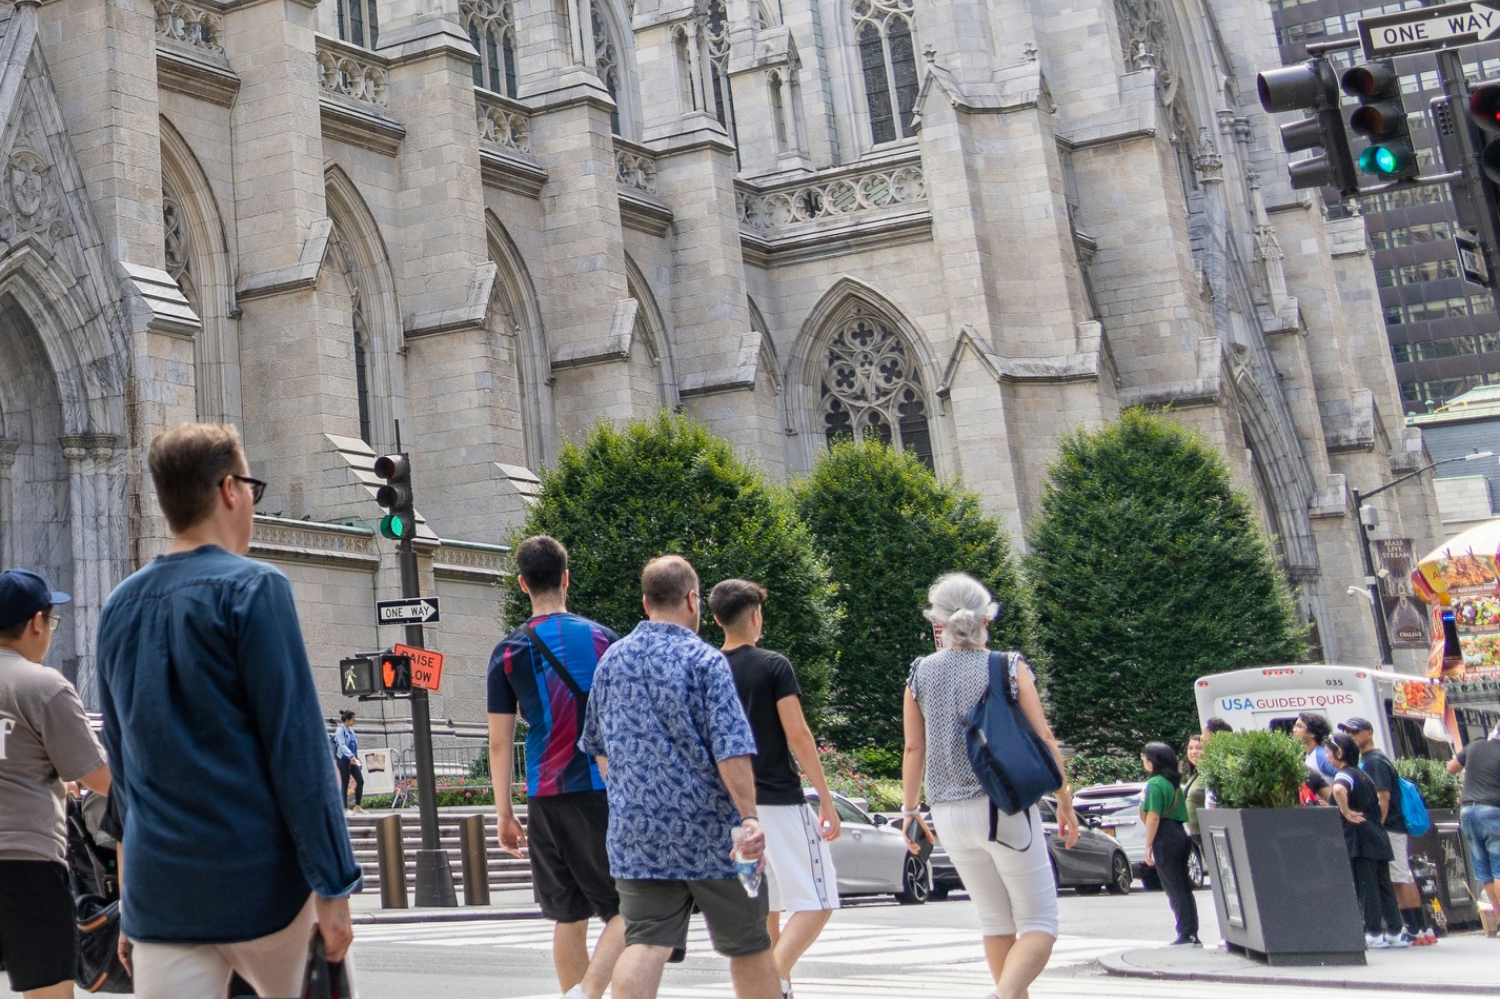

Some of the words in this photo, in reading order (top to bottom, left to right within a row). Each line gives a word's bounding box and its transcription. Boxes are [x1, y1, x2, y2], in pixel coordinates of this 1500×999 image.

[1383, 22, 1429, 45] ONE
[1447, 11, 1494, 34] WAY
[385, 608, 404, 618] ONE
[410, 606, 430, 617] WAY
[1221, 698, 1255, 711] USA
[1256, 697, 1306, 709] GUIDED
[1307, 694, 1354, 707] TOURS
